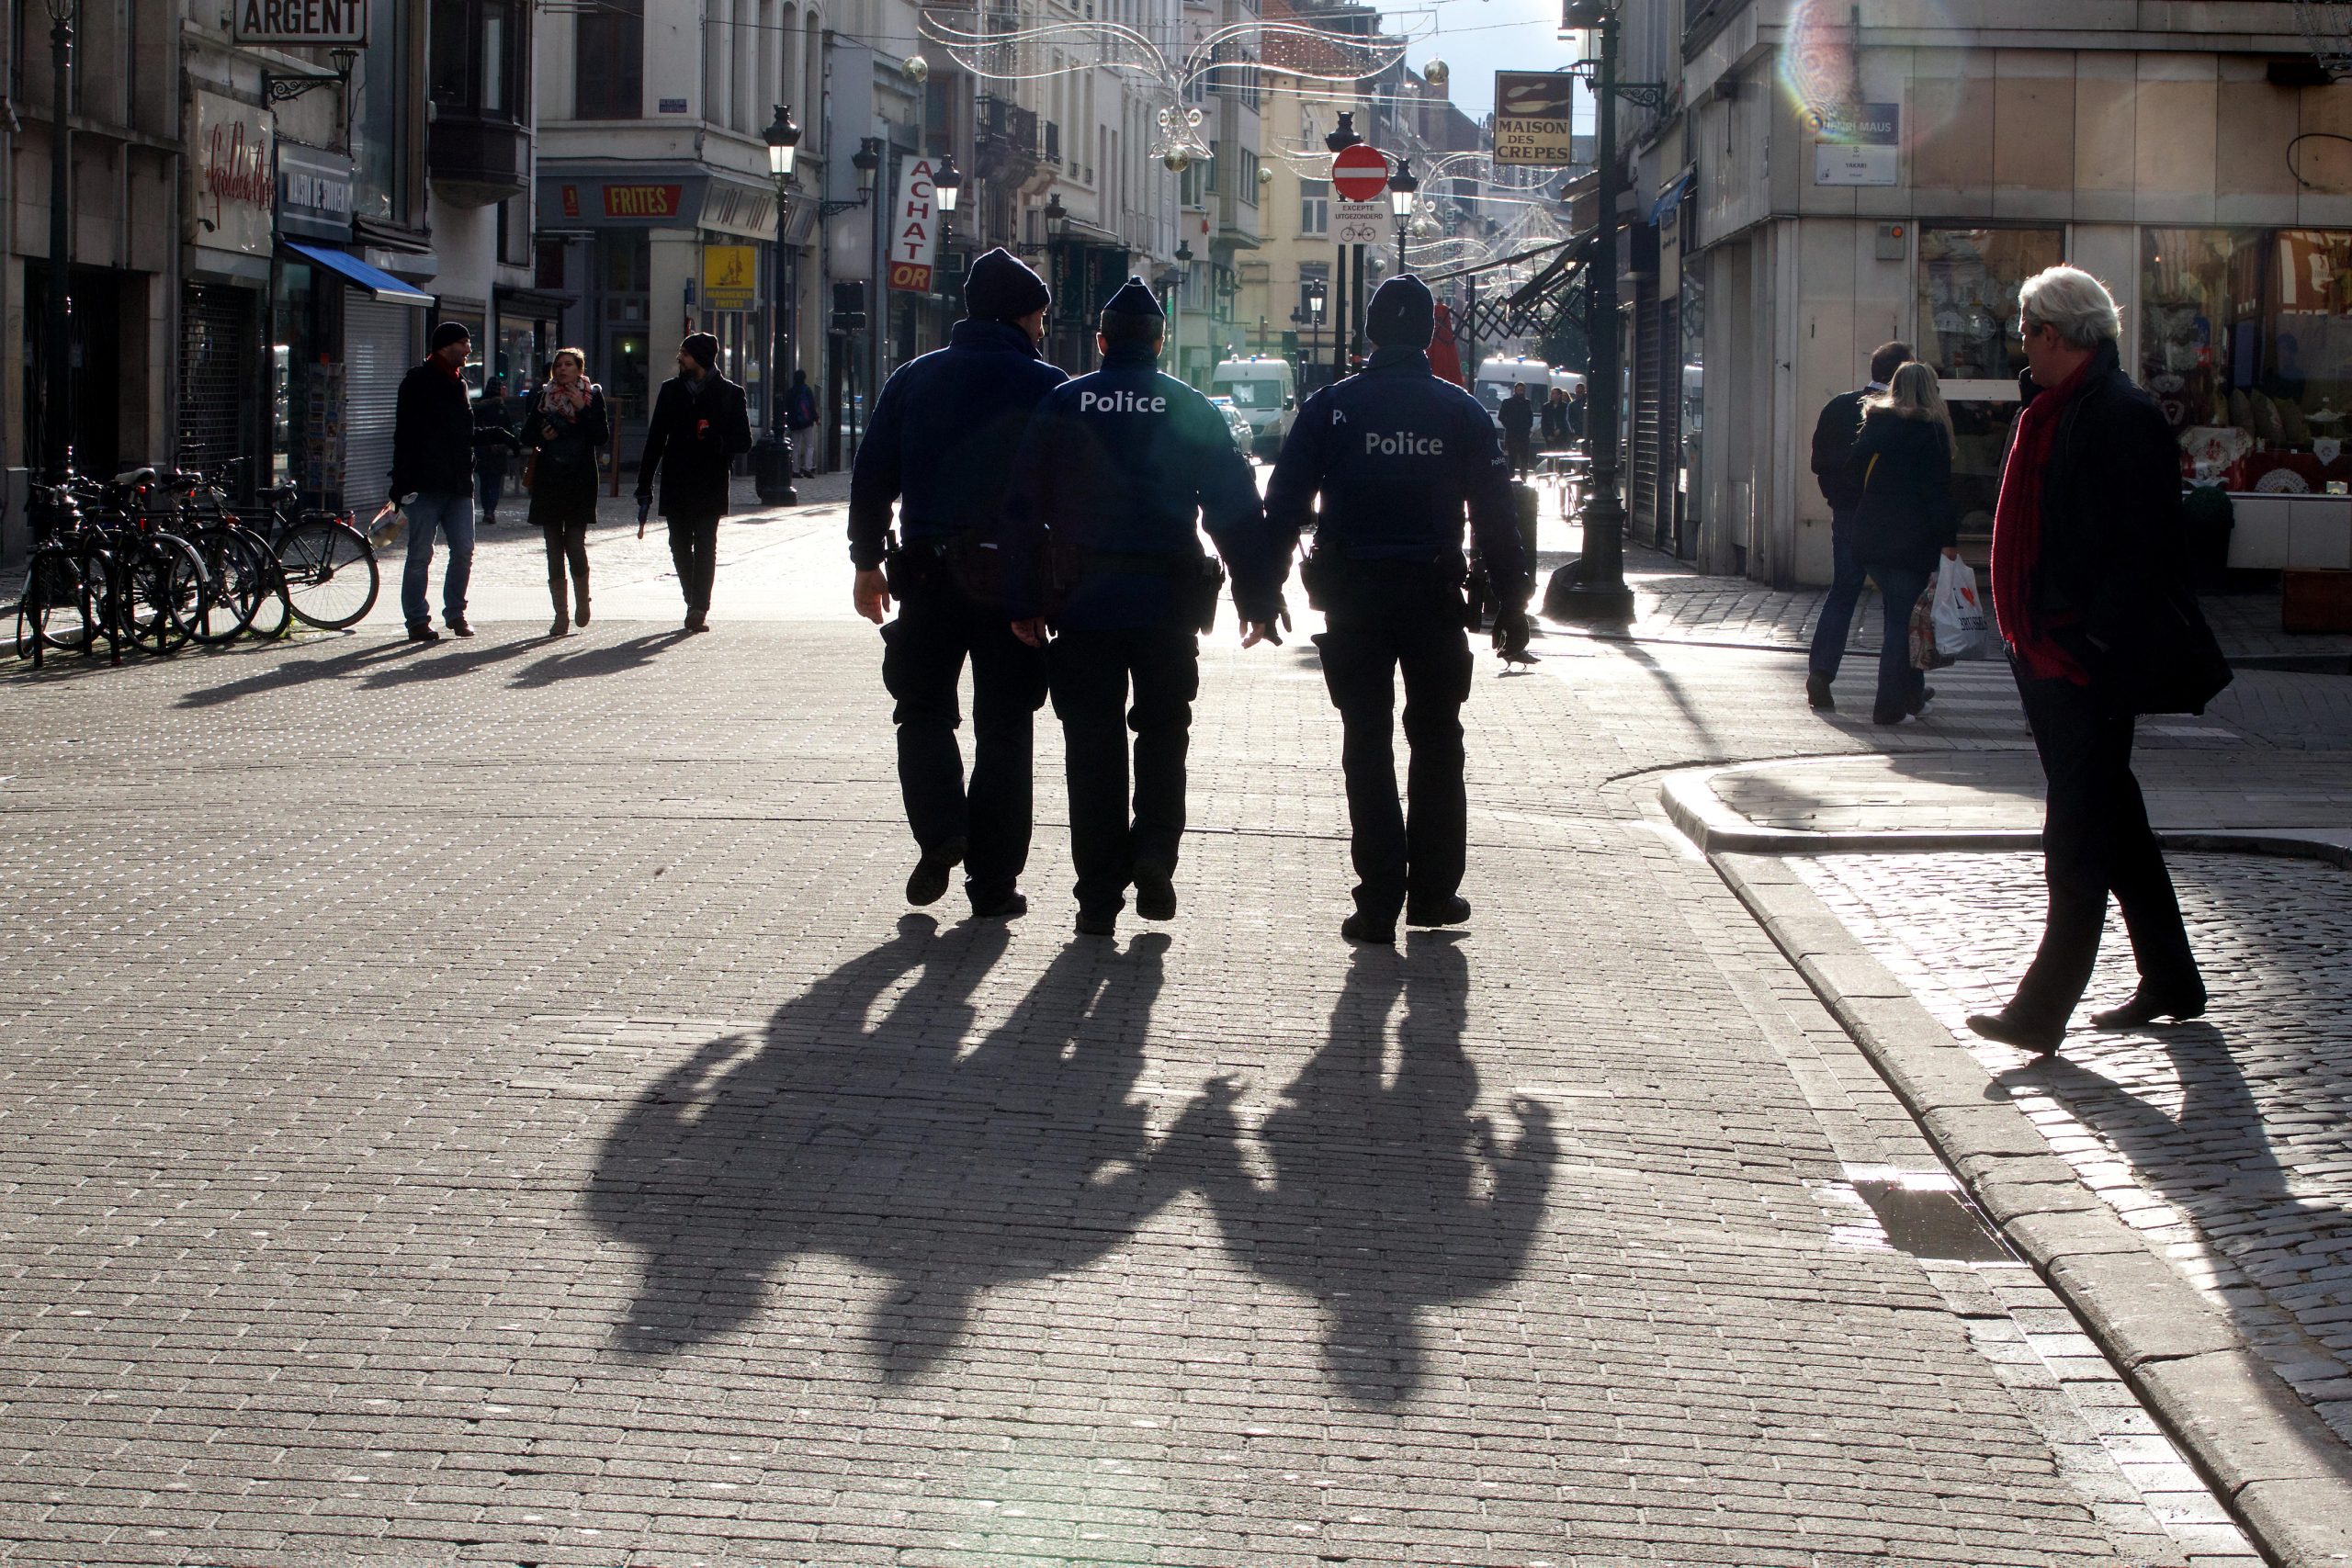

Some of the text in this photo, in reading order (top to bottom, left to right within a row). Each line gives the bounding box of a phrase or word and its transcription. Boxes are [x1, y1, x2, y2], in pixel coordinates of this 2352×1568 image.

[243, 0, 360, 34] ARGENT
[1498, 120, 1568, 134] MAISON
[1823, 120, 1892, 132] HENRI MAUS
[1507, 135, 1535, 144] DES
[1497, 145, 1568, 160] CREPES
[610, 186, 669, 214] FRITES
[901, 160, 934, 260] ACHAT
[893, 265, 929, 288] OR
[715, 299, 744, 308] FRITES
[1080, 390, 1167, 413] Police
[1365, 431, 1443, 456] Police
[1952, 587, 1964, 610] I
